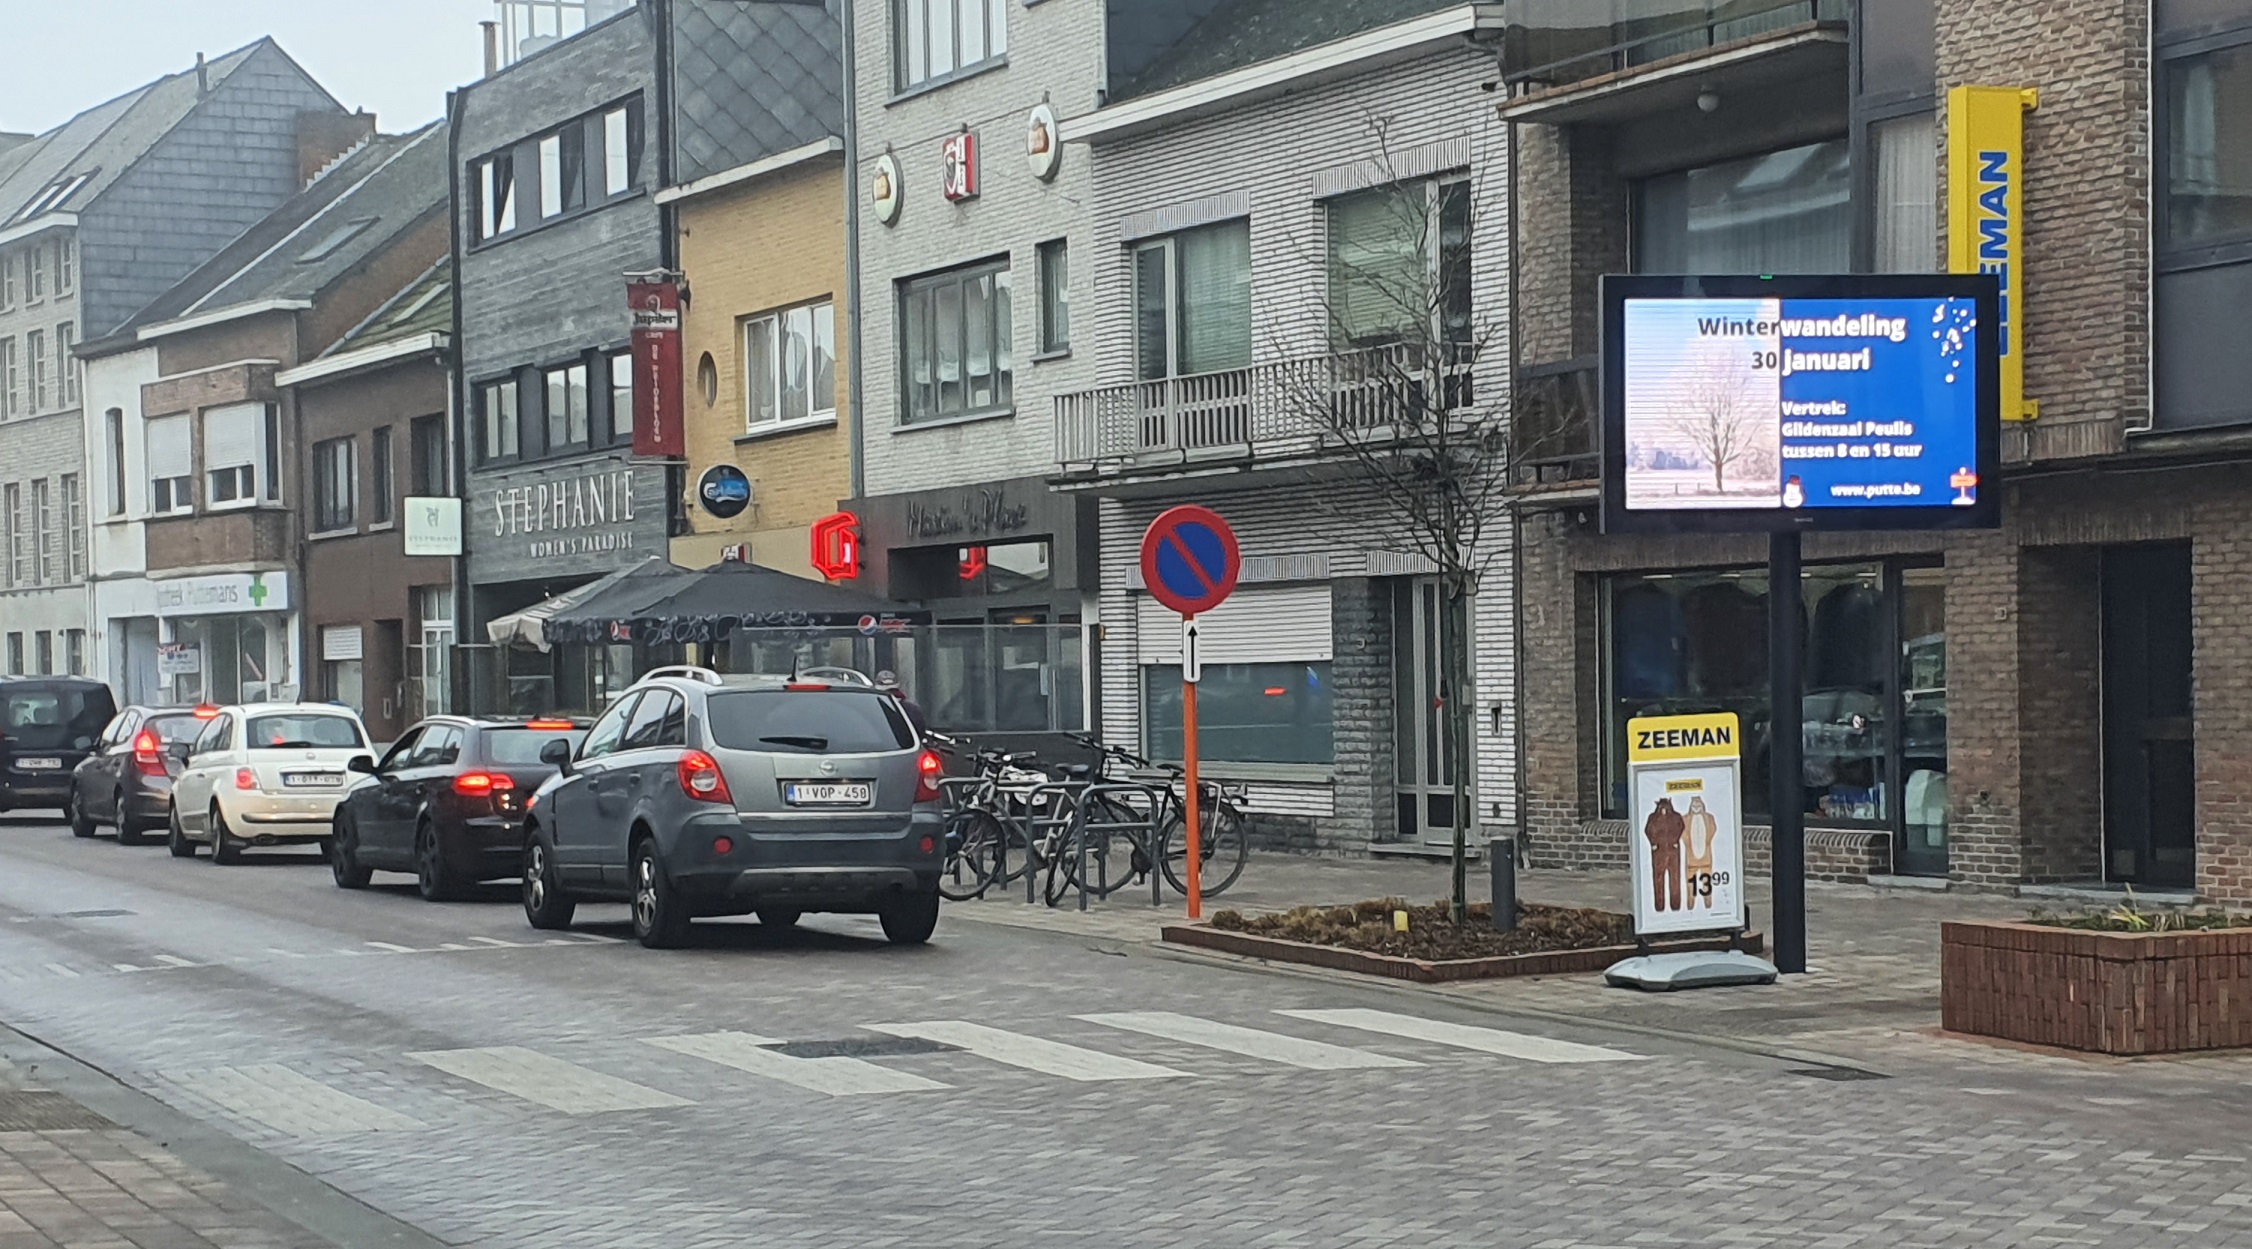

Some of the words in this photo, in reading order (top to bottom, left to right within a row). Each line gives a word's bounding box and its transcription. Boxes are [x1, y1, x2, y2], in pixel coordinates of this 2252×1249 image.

[1697, 314, 1906, 342] Winterwandeling
[1751, 351, 1777, 370] 30
[1781, 347, 1871, 377] januari
[1781, 399, 1847, 416] Vertrek:
[1781, 421, 1863, 437] Gildenzaal
[1865, 420, 1913, 437] Peulis
[1781, 443, 1835, 459] tussen
[1849, 444, 1871, 458] en
[1873, 442, 1891, 458] 15
[1893, 443, 1923, 458] uur
[1829, 481, 1921, 499] www.putte.be
[495, 470, 636, 537] STEPHANIE
[530, 537, 577, 558] WOMEN'S
[581, 530, 634, 553] PARADISE
[1637, 726, 1731, 750] ZEEMAN
